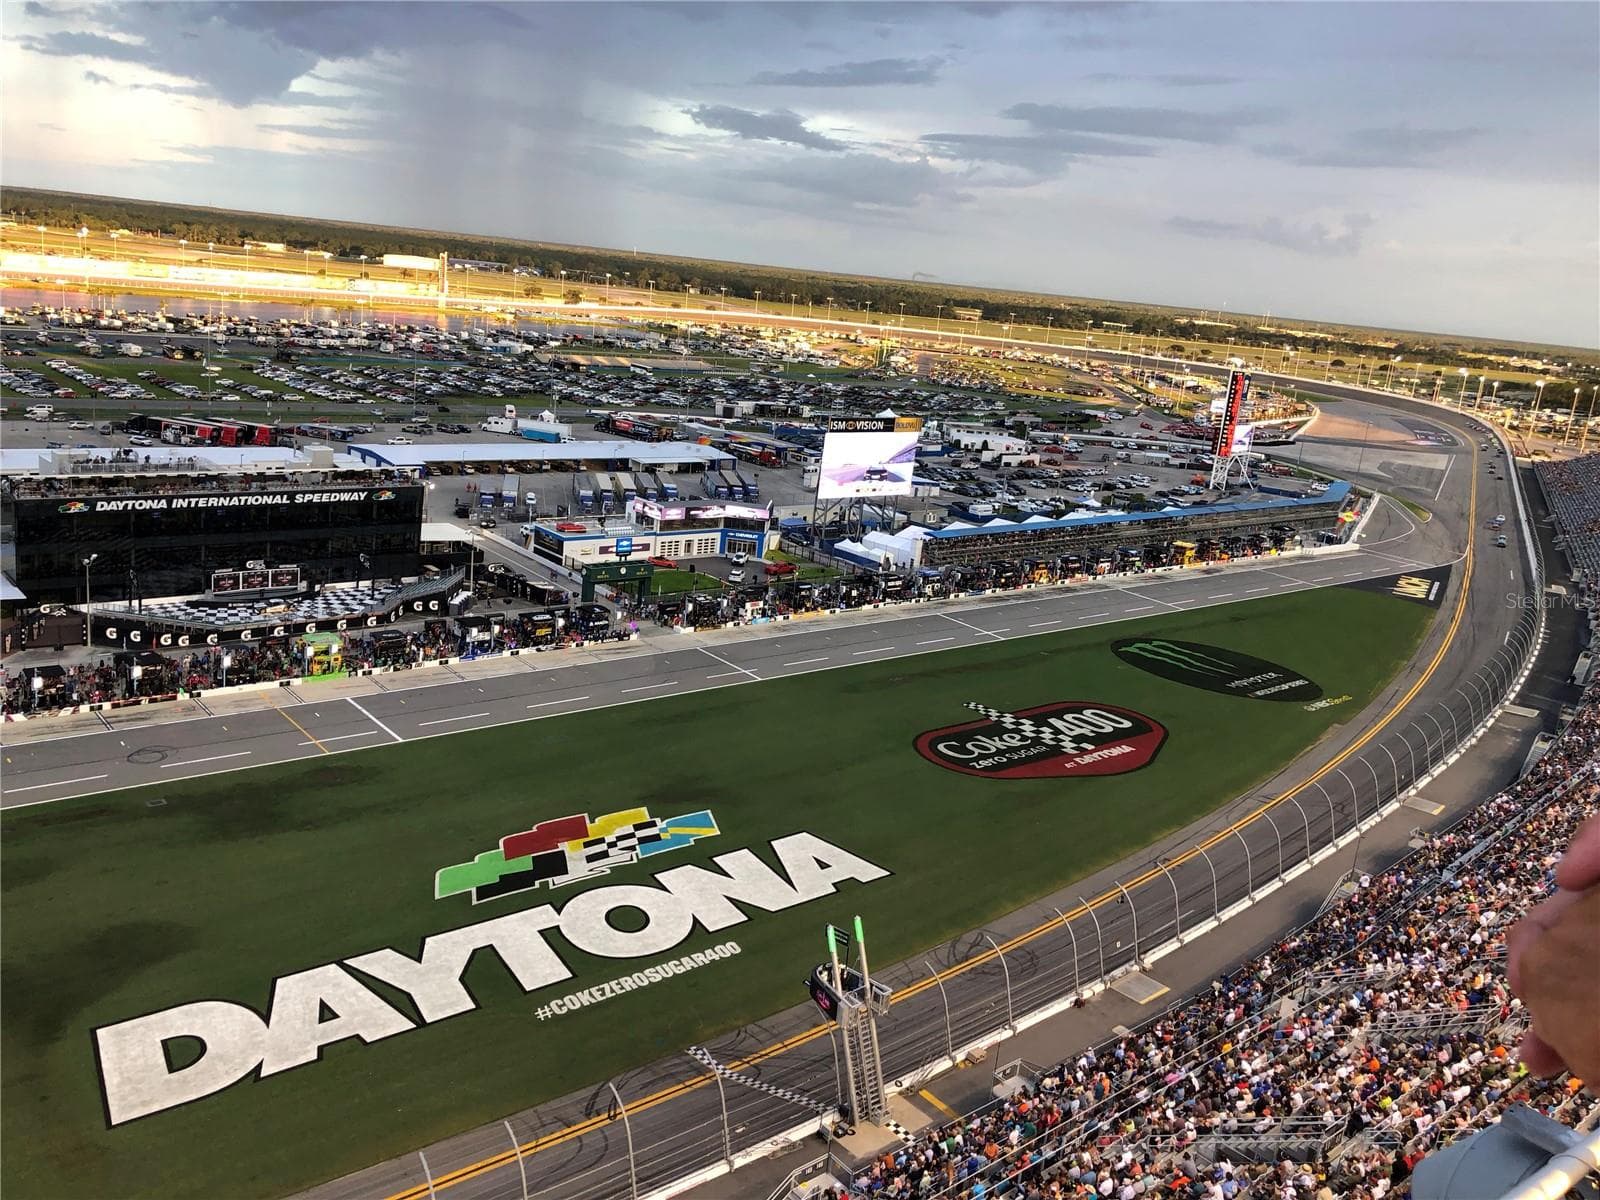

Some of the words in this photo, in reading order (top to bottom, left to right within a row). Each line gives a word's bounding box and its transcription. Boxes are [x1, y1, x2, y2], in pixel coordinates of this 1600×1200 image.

[830, 421, 846, 430] ISM
[856, 421, 884, 430] VISION
[95, 499, 168, 512] DAYTONA
[171, 494, 291, 509] INTERNATIONAL
[294, 491, 368, 504] SPEEDWAY
[413, 601, 424, 612] G
[428, 600, 439, 611] G
[337, 619, 347, 631] G
[366, 616, 377, 627] G
[105, 627, 118, 640] G
[273, 626, 284, 637] G
[305, 623, 316, 634] G
[129, 630, 142, 642] G
[160, 633, 172, 646] G
[178, 635, 190, 647] G
[206, 633, 218, 646] G
[240, 629, 252, 641] G
[936, 731, 1032, 759] Coke
[1047, 708, 1133, 737] 400
[969, 755, 1008, 770] zero
[1004, 745, 1050, 761] SUGAR
[1064, 761, 1078, 769] AT
[1073, 745, 1137, 765] DAYTONA
[91, 831, 895, 1130] DAYTONA
[534, 941, 742, 1021] #COKEZEROSUGAR400
